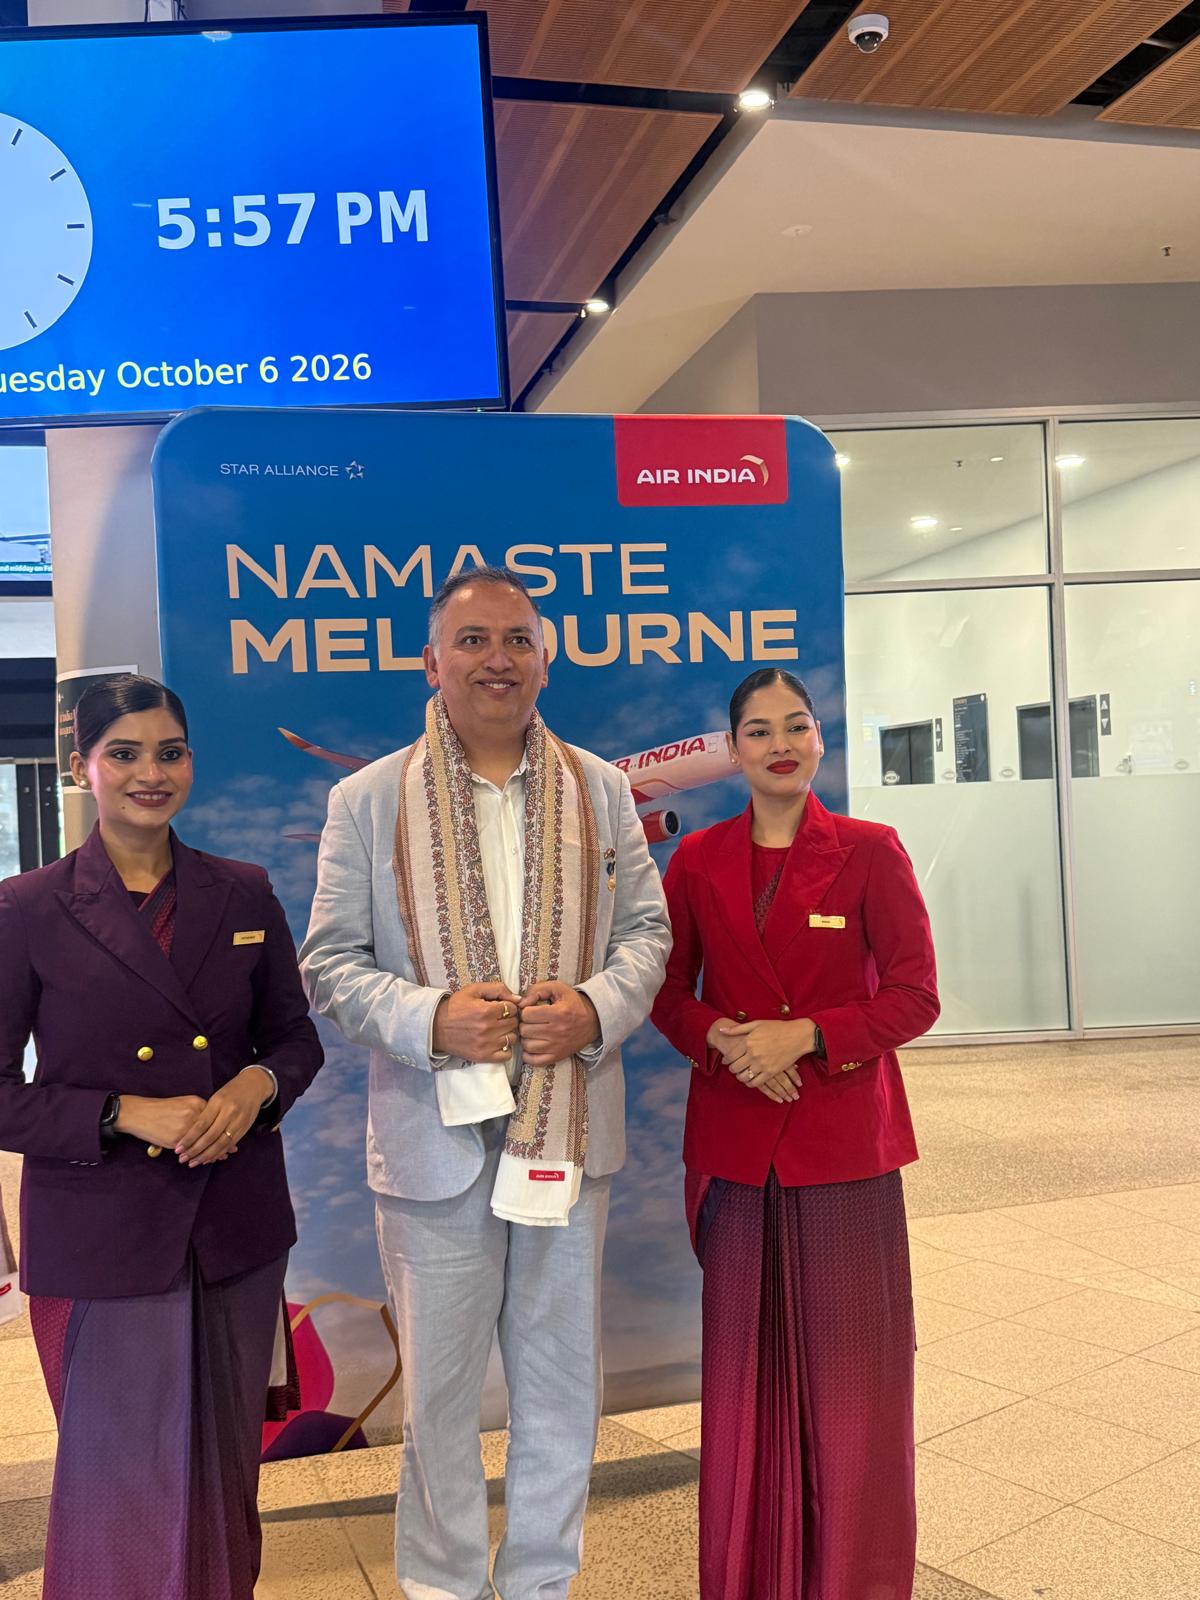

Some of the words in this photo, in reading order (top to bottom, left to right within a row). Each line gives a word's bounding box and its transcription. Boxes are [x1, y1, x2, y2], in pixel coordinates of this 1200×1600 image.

[157, 192, 316, 250] 5:57
[336, 189, 429, 245] PM
[117, 358, 249, 389] October
[259, 355, 279, 384] 6
[290, 353, 373, 384] 2026
[220, 463, 259, 475] STAR
[264, 464, 339, 477] ALLIANCE
[636, 469, 680, 485] AIR
[687, 468, 757, 485] INDIA
[230, 608, 800, 675] MELURNE
[638, 737, 706, 769] INDIA
